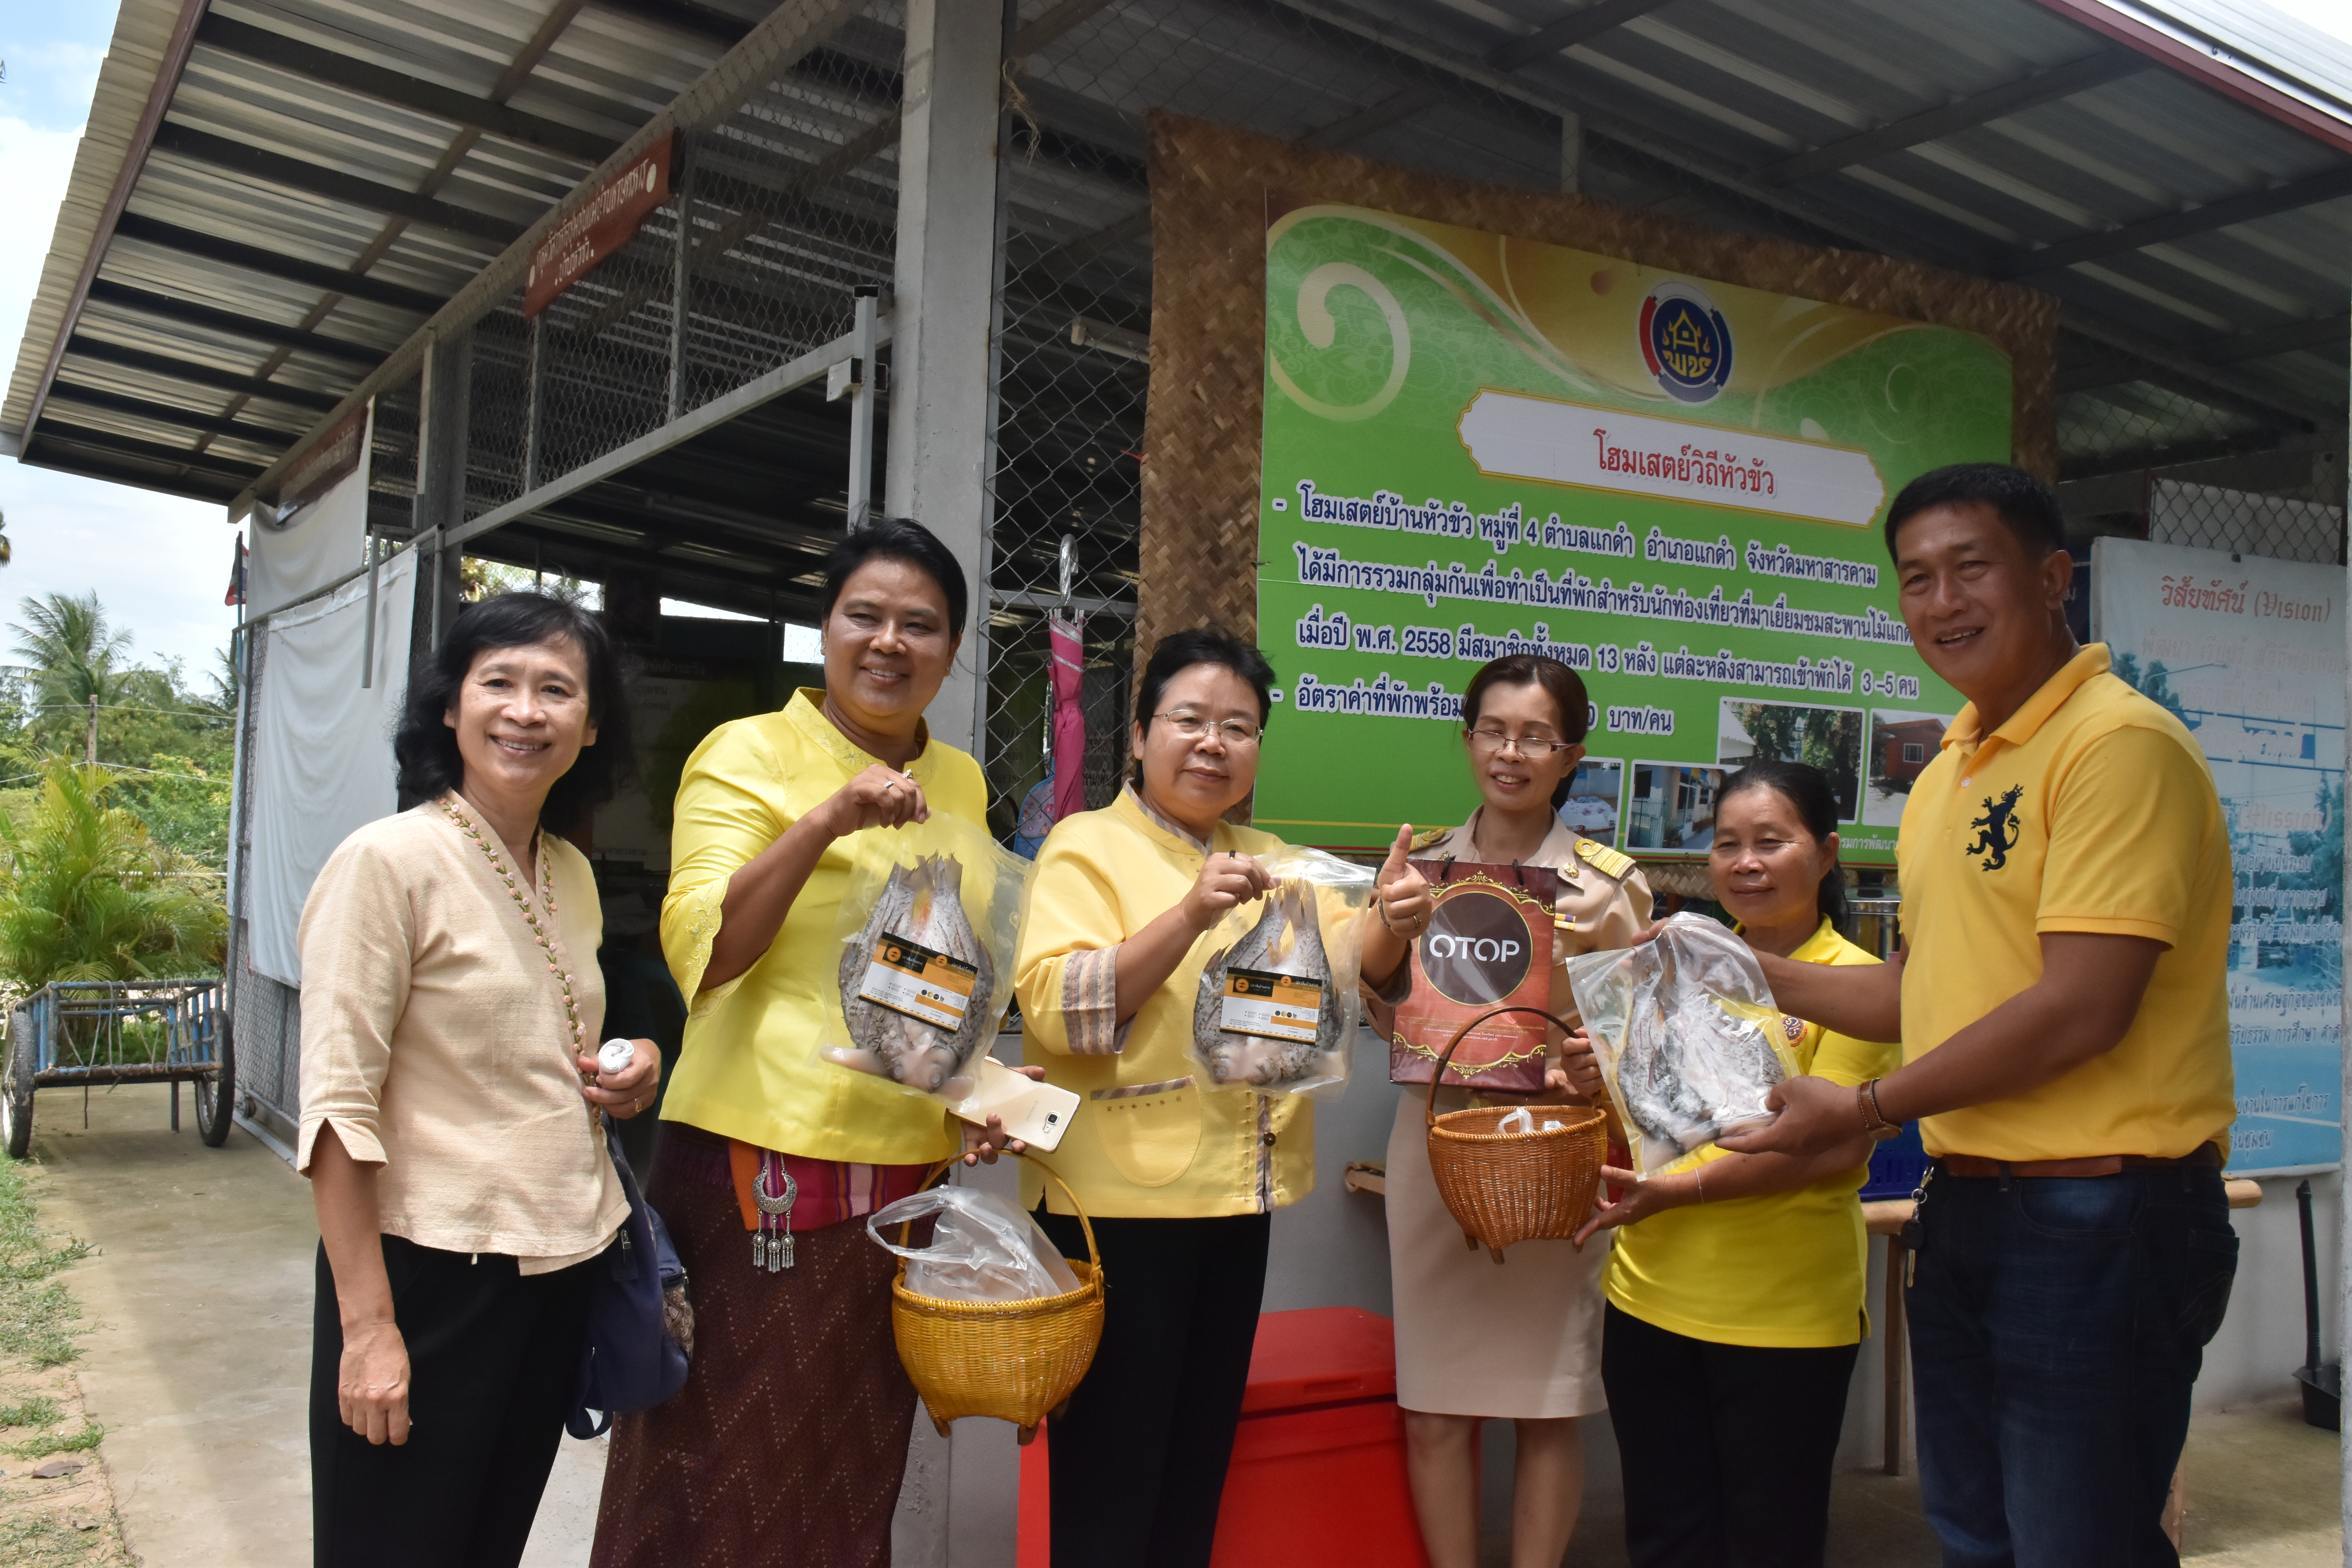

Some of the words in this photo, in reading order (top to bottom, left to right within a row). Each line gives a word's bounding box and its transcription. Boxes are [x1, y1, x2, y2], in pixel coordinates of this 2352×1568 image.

[1594, 429, 1774, 494] โฮมเสตย์วิถีหัวขัว
[1299, 483, 1472, 535] โฮมเสตย์บ้านหัวขัว
[1480, 506, 1519, 550] หมู่ที่
[1526, 521, 1537, 542] 4
[1545, 517, 1633, 554] ตำบลแกดำ
[1647, 530, 1734, 566] อำเภอแกดำ
[1747, 543, 1876, 585] จังหวัดมหาสารคาม
[2254, 590, 2332, 624] (Vision)
[1299, 608, 1347, 646] เมื่อปี
[1356, 628, 1396, 650] พ.ศ.
[1404, 629, 1451, 655] 2558
[1598, 648, 1617, 669] 13
[1624, 644, 1656, 672] หลัง
[1664, 650, 1852, 690] แต่ละหลังสามารถเข้าพักได้
[1899, 679, 1917, 697] คน
[1610, 709, 1672, 732] บาท/คน
[1839, 834, 1898, 850] รมการพัฒนา
[1429, 934, 1520, 962] OTOP
